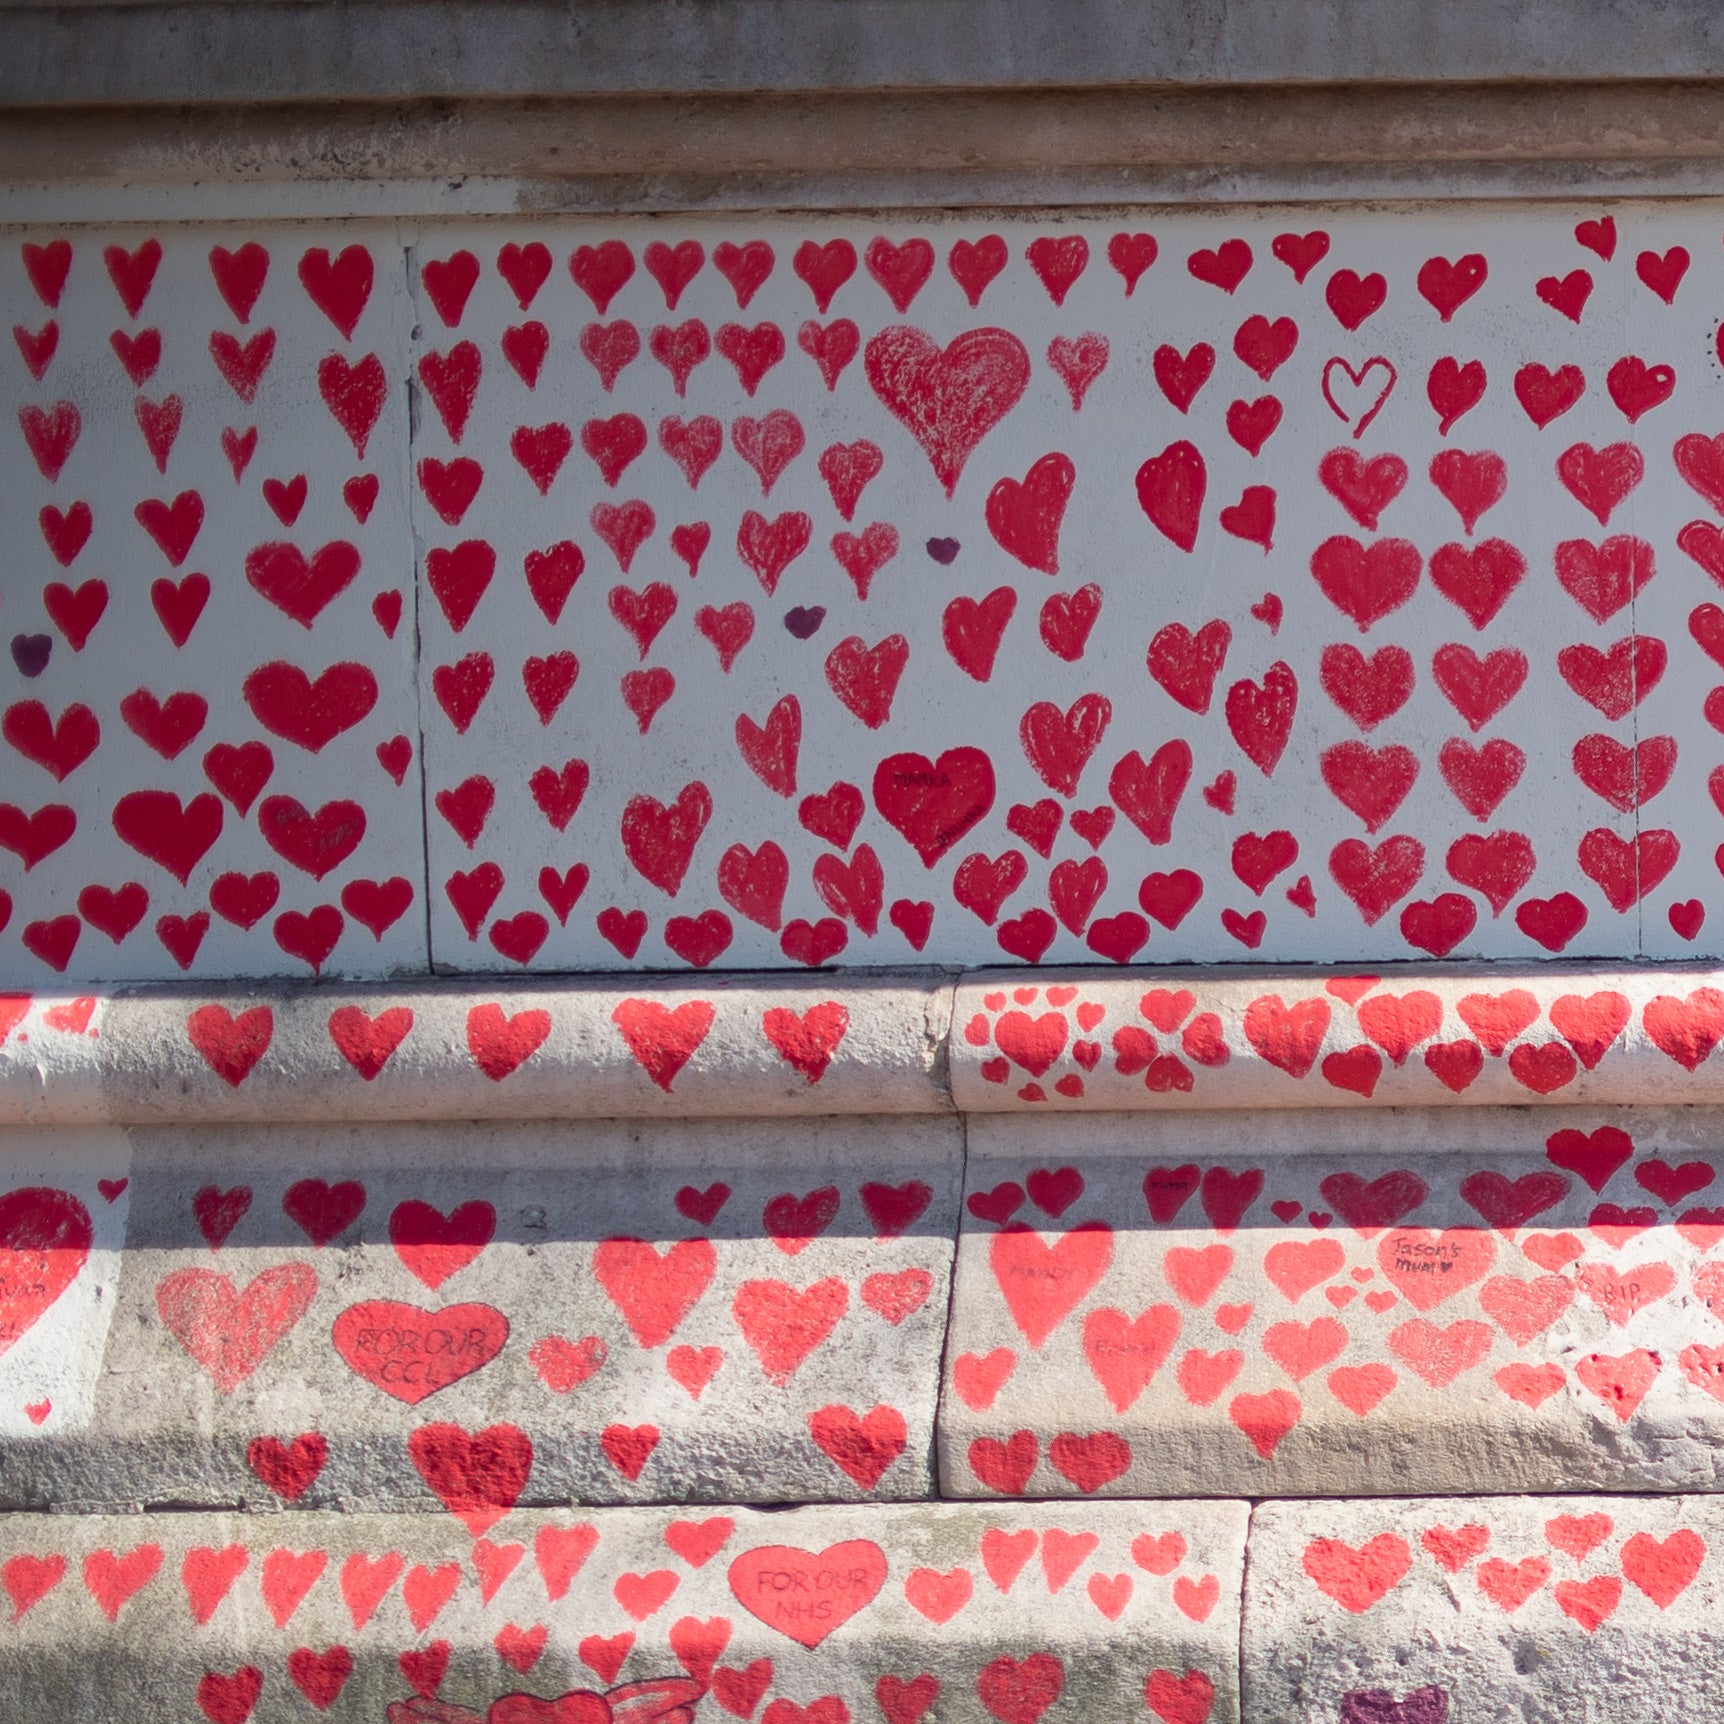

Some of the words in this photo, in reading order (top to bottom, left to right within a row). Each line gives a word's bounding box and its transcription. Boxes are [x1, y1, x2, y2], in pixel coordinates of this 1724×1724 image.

[425, 1328, 486, 1356] OUR
[756, 1569, 813, 1595] FOR
[817, 1567, 869, 1591] OUR
[774, 1597, 833, 1622] NHS
